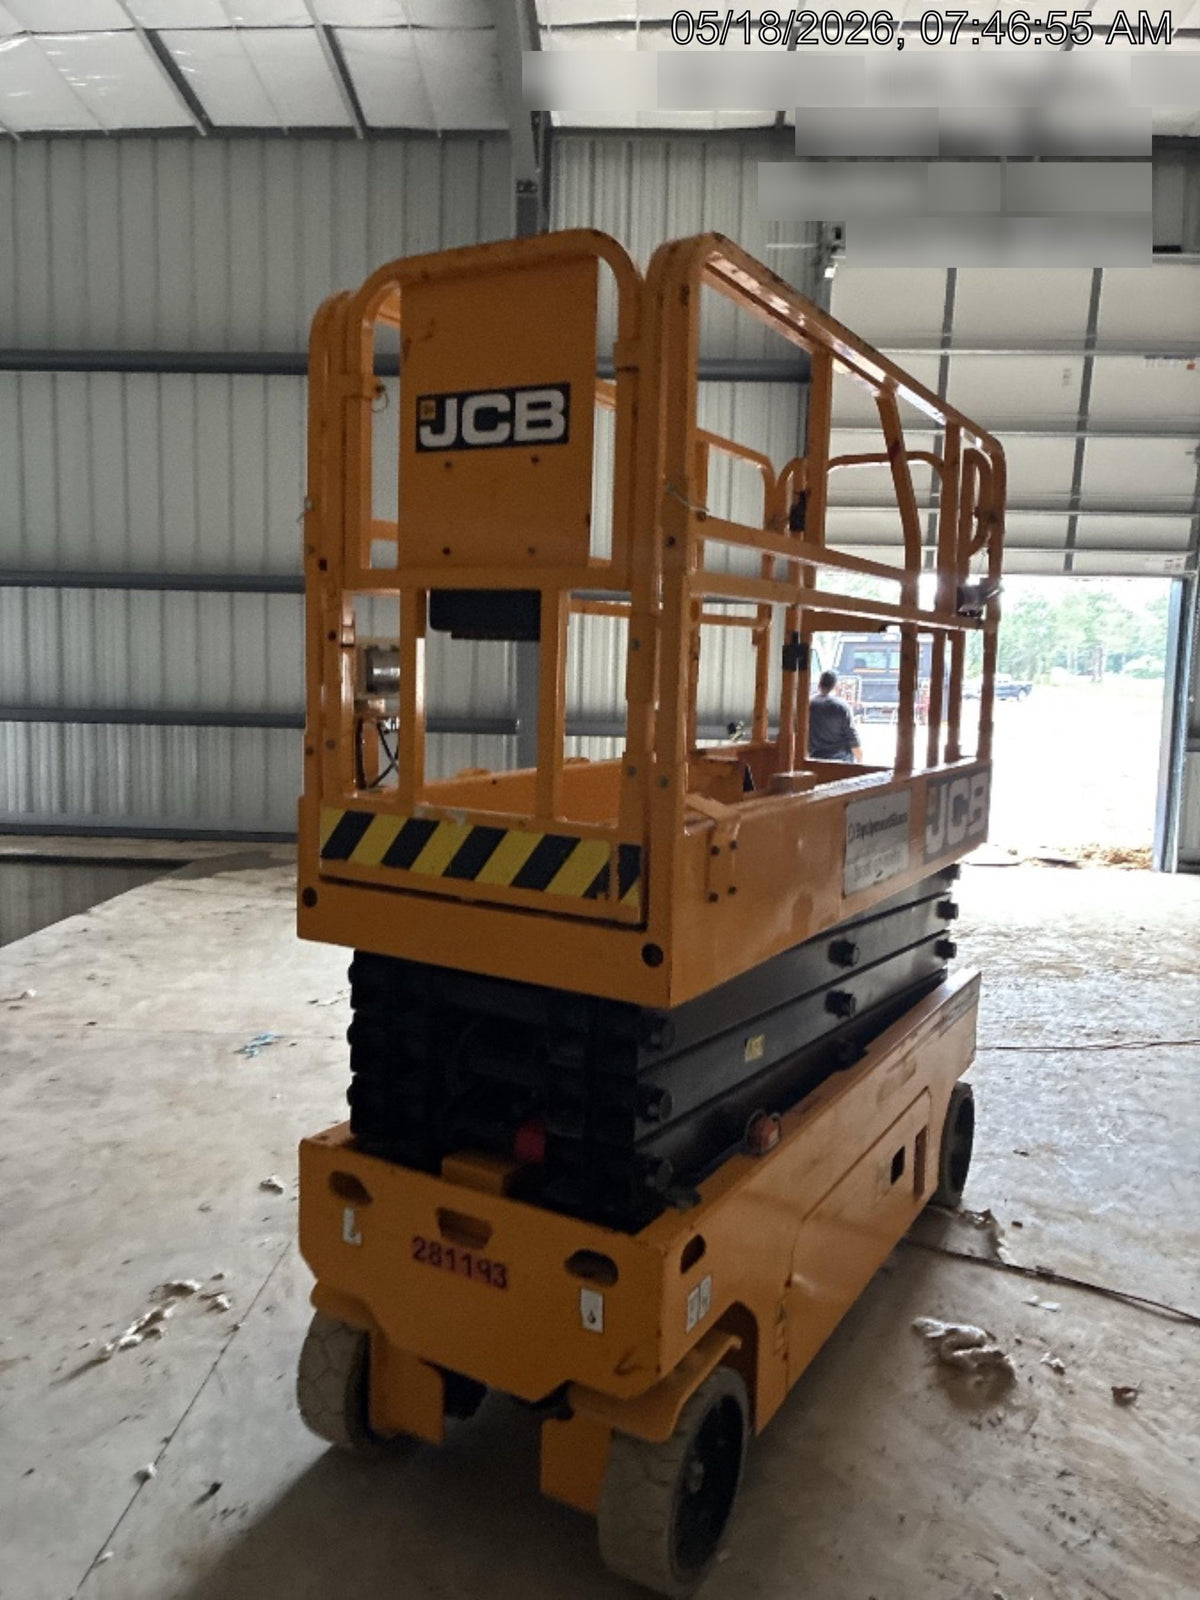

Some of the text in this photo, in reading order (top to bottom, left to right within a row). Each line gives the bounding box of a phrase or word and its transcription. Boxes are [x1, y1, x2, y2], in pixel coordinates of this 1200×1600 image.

[419, 389, 566, 448] JCB
[925, 772, 989, 854] JCB
[412, 1235, 508, 1290] 281193
